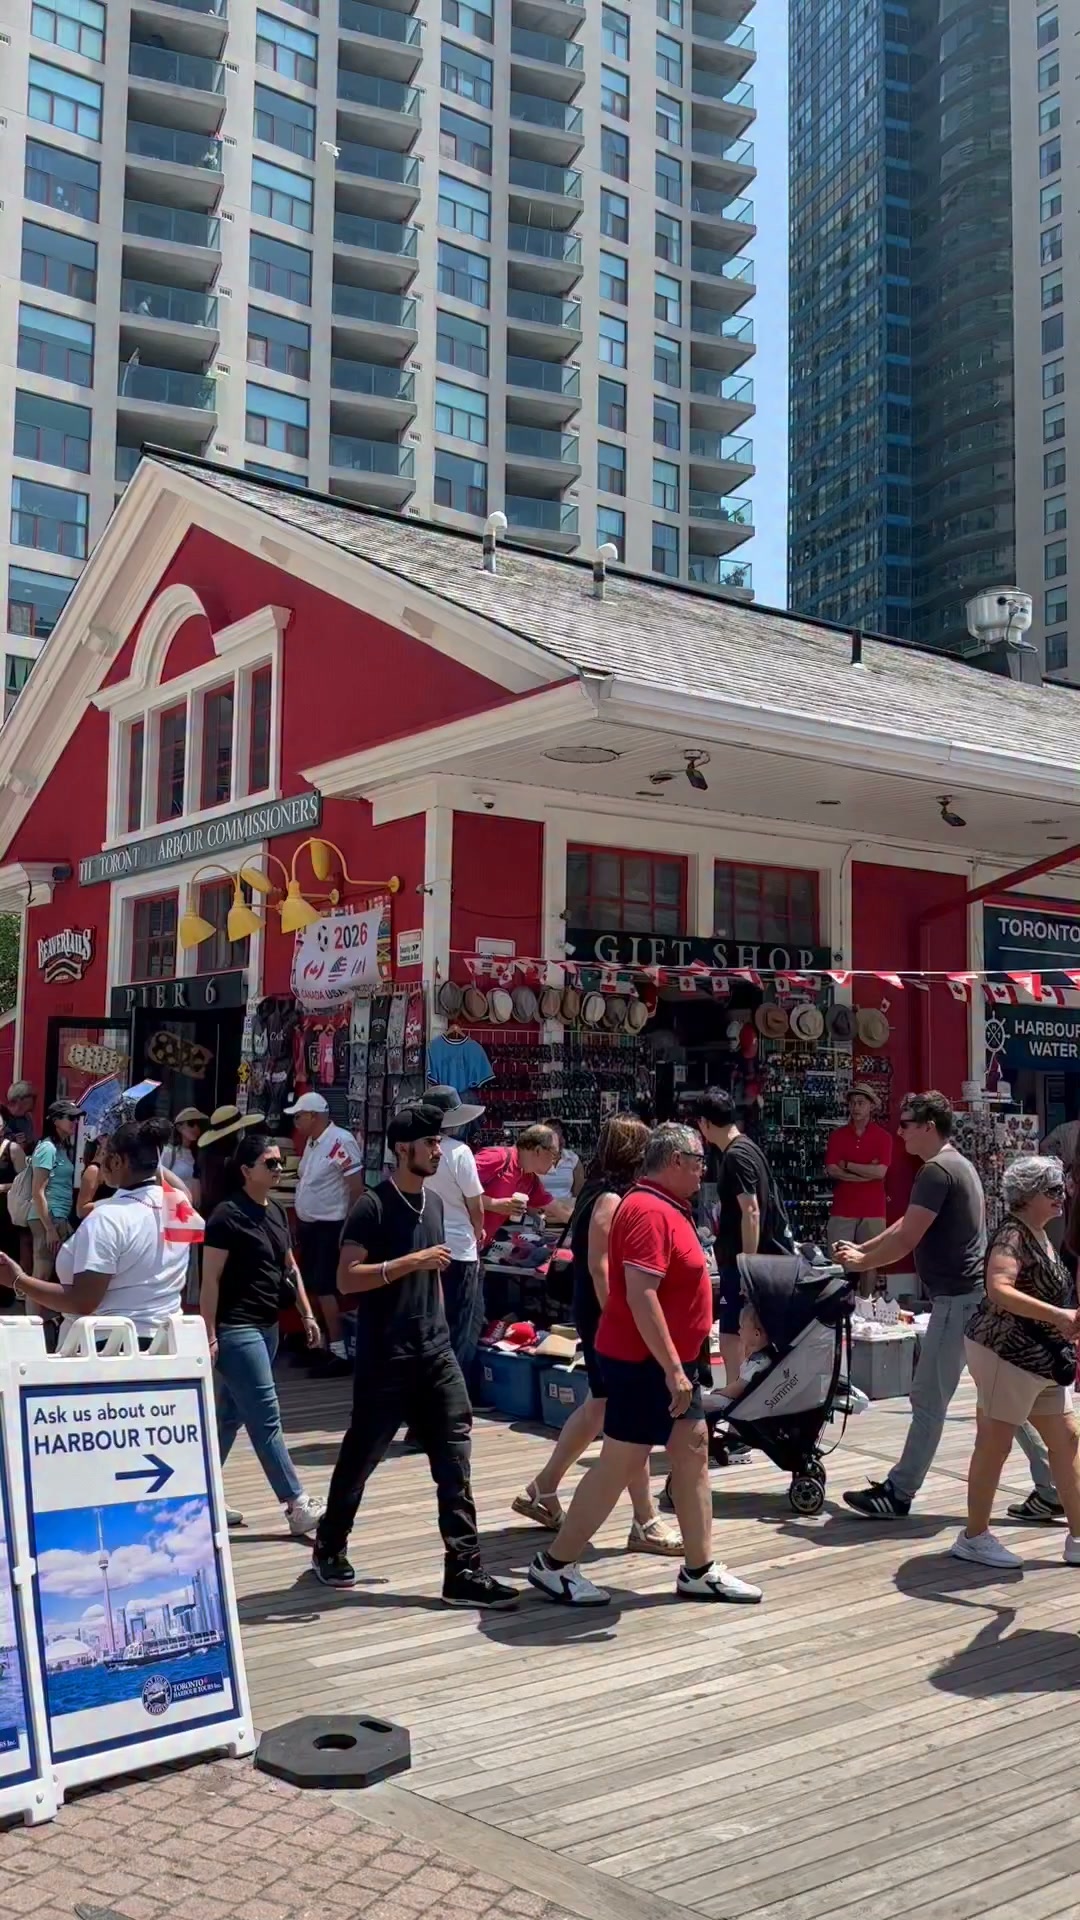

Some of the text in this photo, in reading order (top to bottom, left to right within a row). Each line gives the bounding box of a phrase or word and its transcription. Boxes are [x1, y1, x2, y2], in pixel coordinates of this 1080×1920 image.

[207, 795, 318, 847] COMMISSIONERS
[334, 922, 368, 950] 2026
[997, 917, 1080, 943] TORONTO
[594, 934, 815, 970] GIFT SHOP
[125, 976, 217, 1012] PIER 6
[1028, 1041, 1078, 1058] WATER
[764, 1374, 799, 1409] Summer
[33, 1402, 177, 1425] Ask us about our
[33, 1424, 199, 1456] HARBOUR TOUR
[172, 1679, 204, 1691] TORONTO
